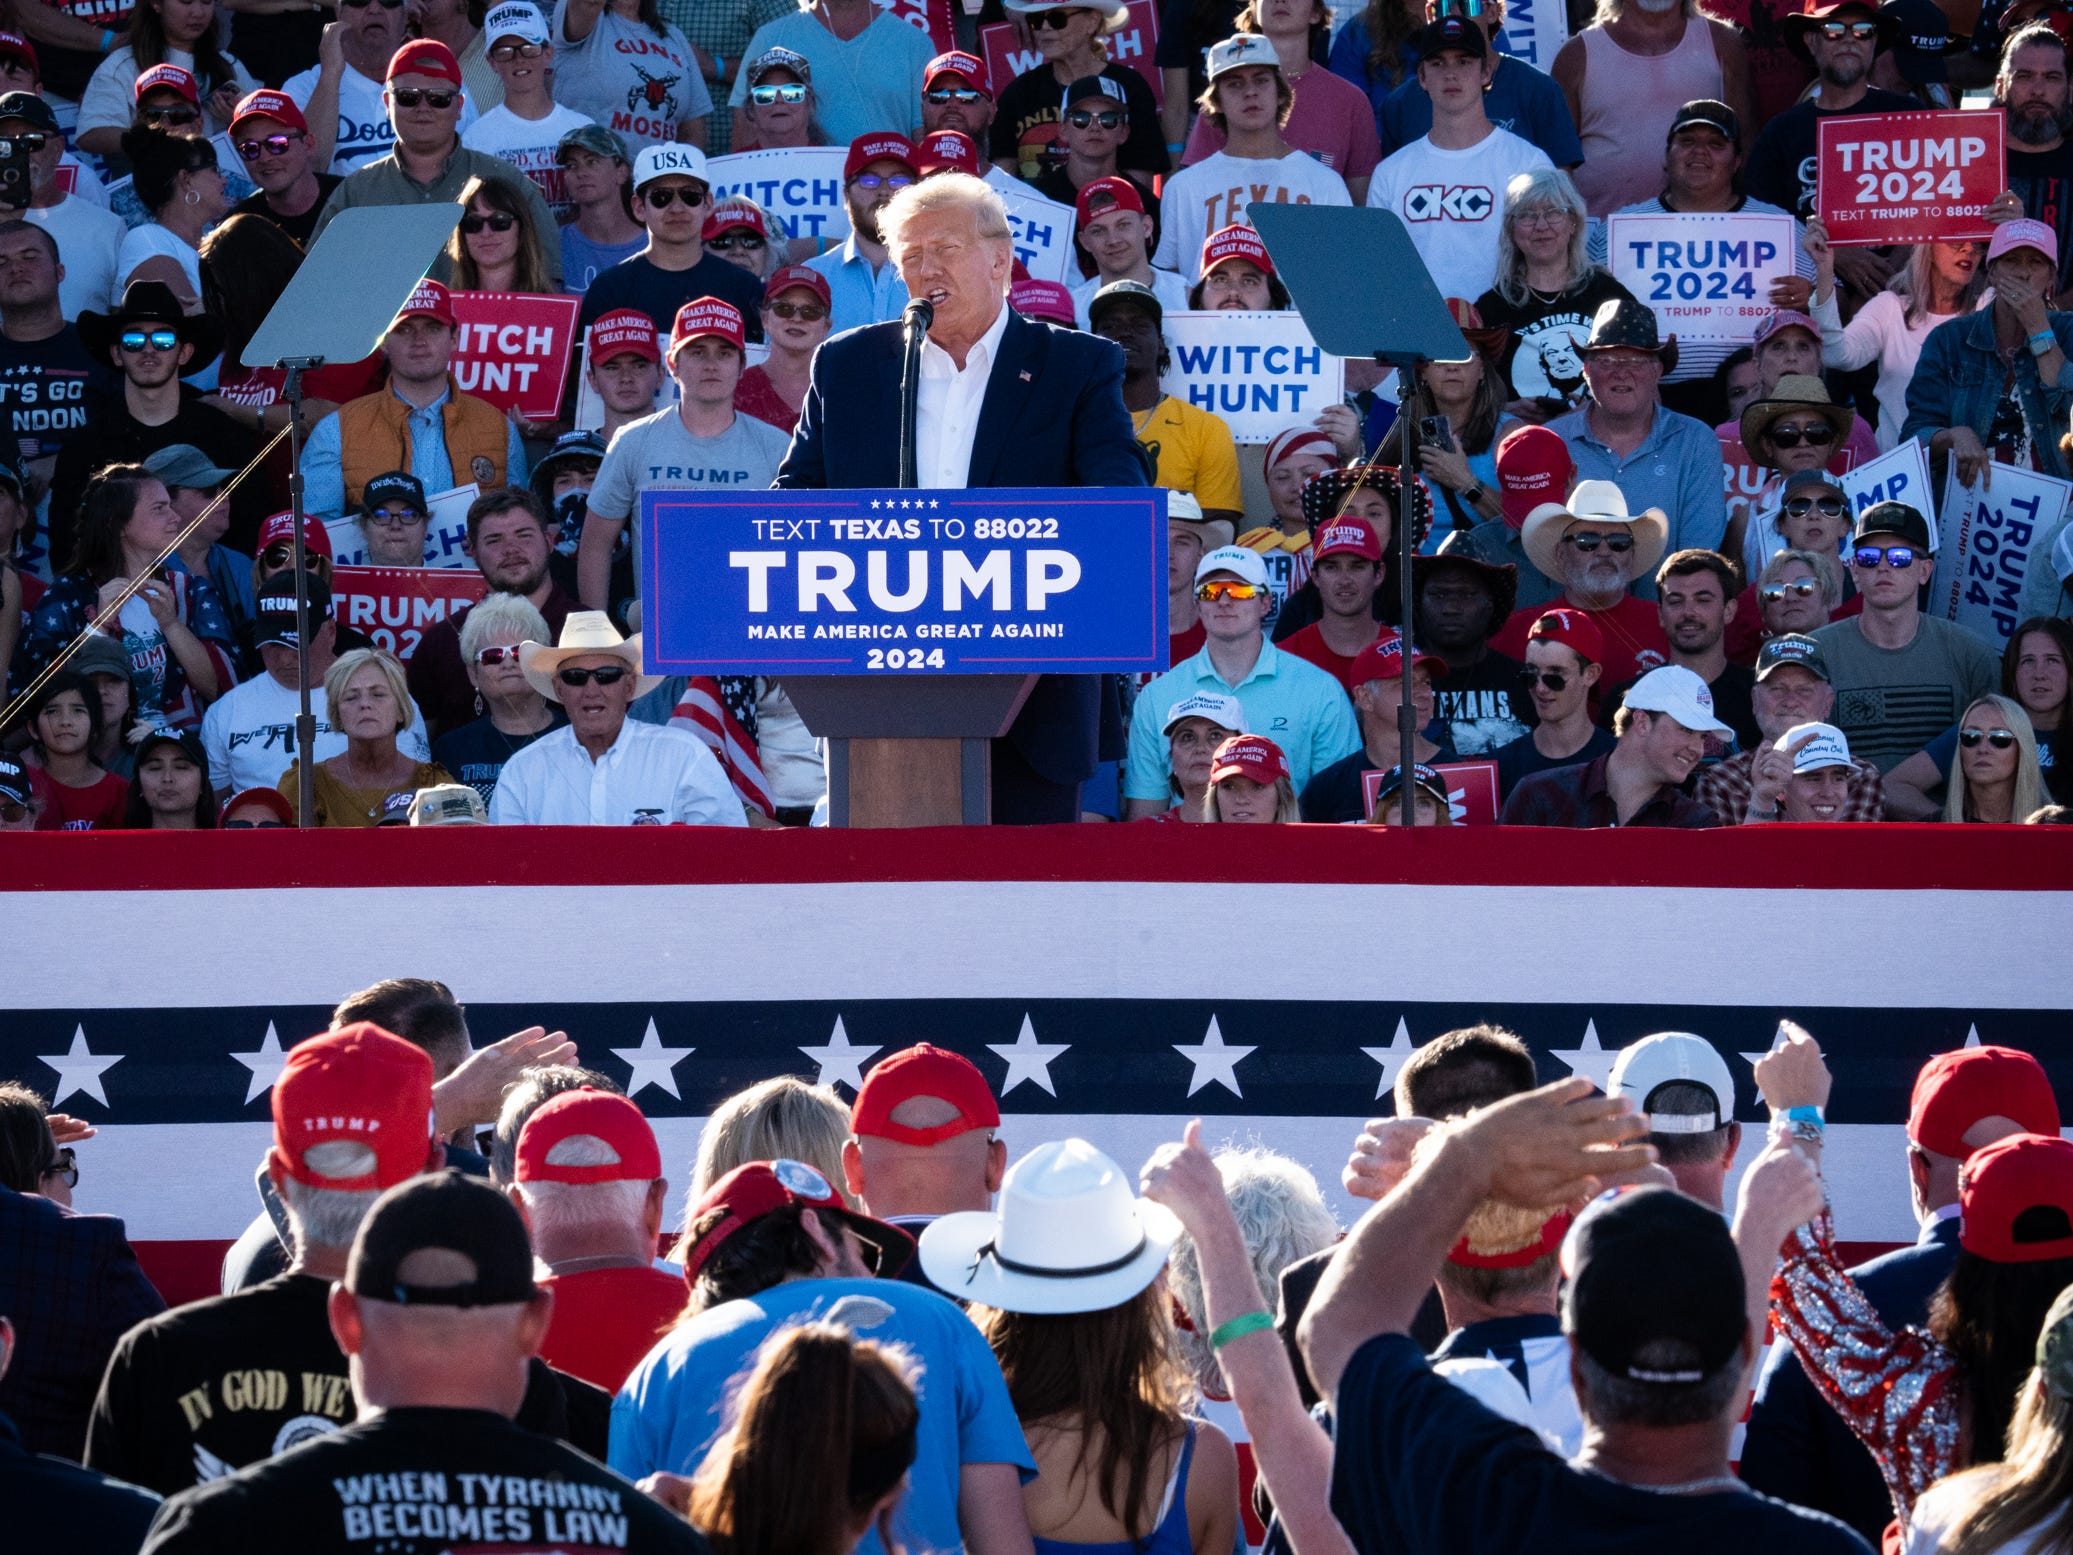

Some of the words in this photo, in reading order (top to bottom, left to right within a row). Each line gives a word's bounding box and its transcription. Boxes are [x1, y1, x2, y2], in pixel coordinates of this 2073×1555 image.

[489, 9, 533, 27] TRUMP
[614, 38, 682, 68] GUNS
[611, 111, 676, 141] MOSES
[933, 143, 966, 156] AMERICA
[1836, 137, 1986, 172] TRUMP
[652, 151, 693, 171] USA
[1855, 169, 1964, 203] 2024
[1404, 185, 1494, 222] OKC
[1831, 210, 1865, 221] TEXT
[1871, 207, 1919, 219] TRUMP
[1923, 206, 1942, 218] TO
[1211, 243, 1237, 258] GREAT
[1237, 243, 1264, 258] AGAIN
[1629, 240, 1777, 269] TRUMP
[1650, 271, 1756, 300] 2024
[682, 304, 706, 320] MAKE
[705, 303, 742, 323] AMERICA
[1540, 312, 1581, 328] TIME
[1665, 307, 1712, 317] TRUMP
[1717, 307, 1735, 317] TO
[594, 317, 616, 334] MAKE
[616, 316, 653, 330] AMERICA
[685, 316, 714, 331] GREAT
[713, 317, 739, 333] AGAIN
[598, 330, 624, 345] GREAT
[625, 329, 650, 343] AGAIN
[1177, 345, 1321, 375] WITCH
[48, 380, 84, 401] GO
[1189, 384, 1309, 413] HUNT
[649, 466, 749, 483] TRUMP
[1504, 473, 1521, 482] MAKE
[1522, 472, 1552, 483] AMERICA
[1507, 482, 1528, 490] GREAT
[1528, 480, 1550, 490] AGAIN
[752, 519, 821, 541] TEXT
[829, 519, 921, 540] TEXAS
[929, 518, 965, 540] TO
[974, 517, 1059, 539] 88022
[1323, 526, 1365, 541] Trump
[1959, 511, 1972, 557] TRUMP
[1214, 552, 1246, 561] TRUMP
[1965, 501, 2004, 608] 2024
[1991, 495, 2041, 638] TRUMP
[728, 548, 1082, 613] TRUMP
[748, 624, 806, 639] MAKE
[813, 623, 908, 639] AMERICA
[915, 623, 984, 639] GREAT
[990, 623, 1065, 638] AGAIN!
[866, 647, 946, 669] 2024
[1770, 641, 1815, 656] Trump
[1236, 746, 1267, 757] AMERICA
[1241, 754, 1264, 763] AGAIN
[1799, 743, 1829, 758] Country
[304, 1117, 381, 1132] TRUMP
[178, 1382, 214, 1432] IN
[221, 1368, 289, 1412] GOD
[301, 1371, 349, 1418] WE
[332, 1471, 449, 1505] WHEN
[455, 1472, 622, 1514] TYRANNY
[342, 1502, 532, 1542] BECOMES
[543, 1508, 629, 1548] LAW
